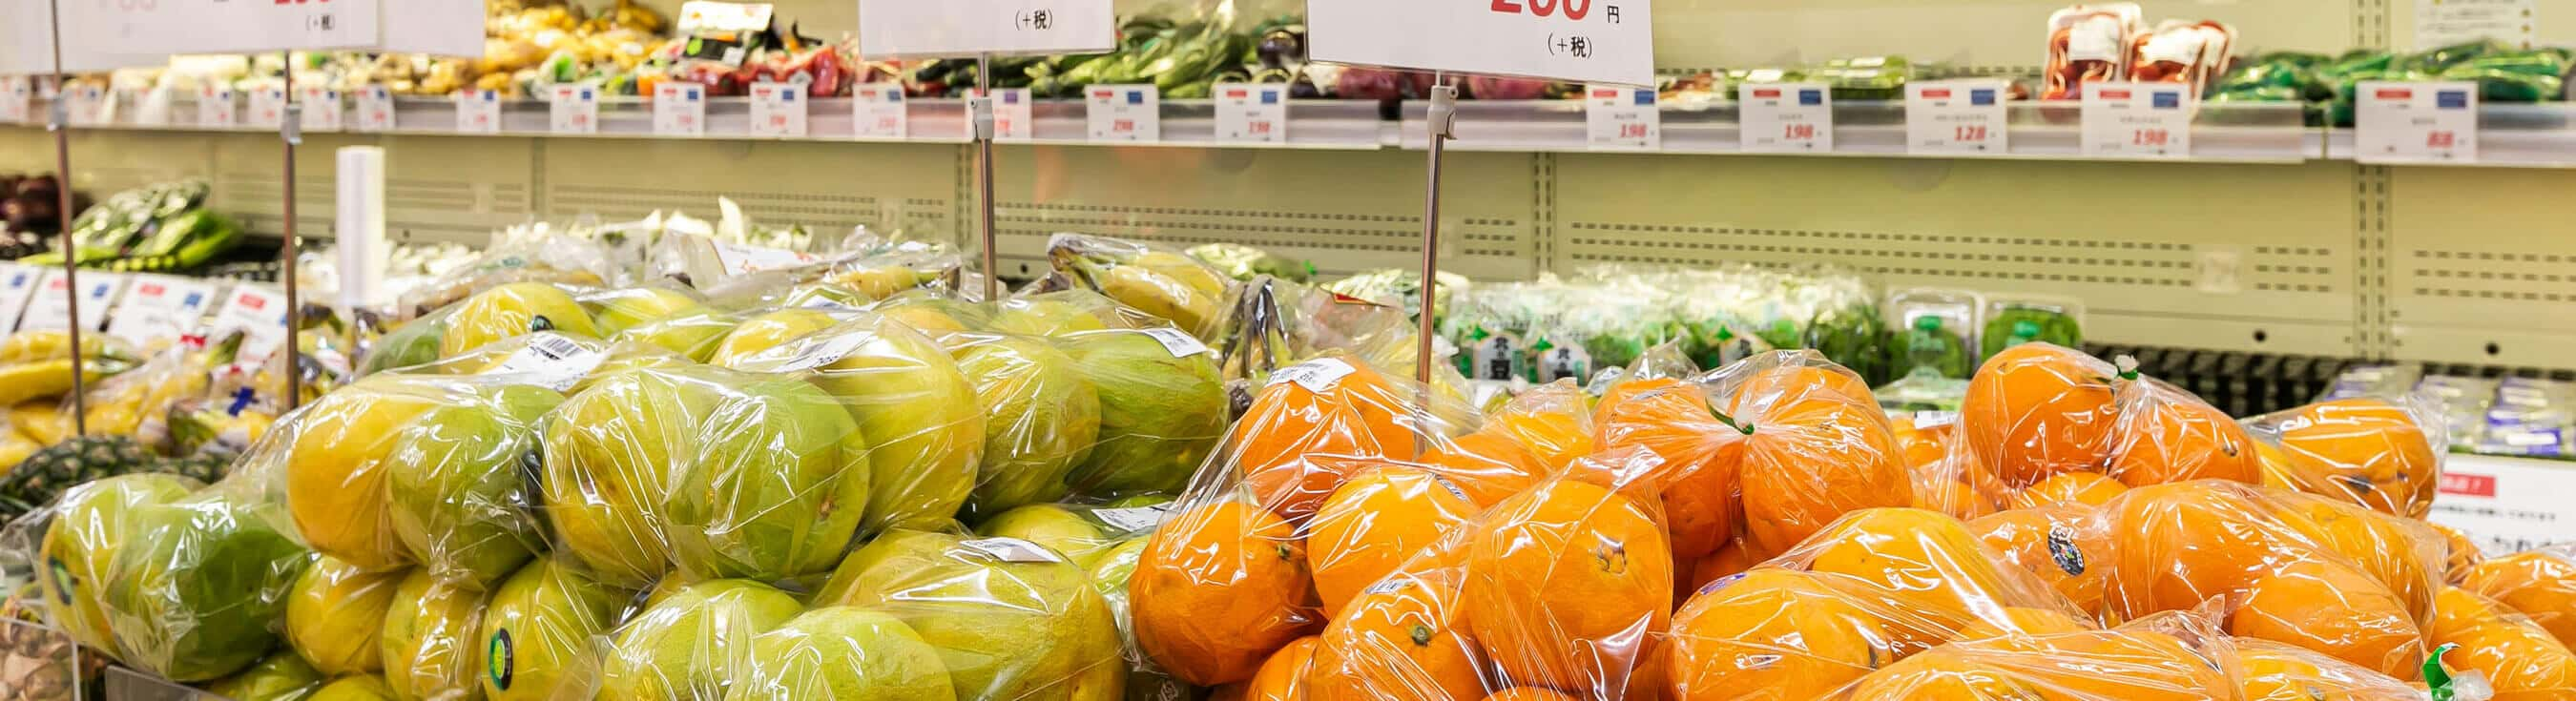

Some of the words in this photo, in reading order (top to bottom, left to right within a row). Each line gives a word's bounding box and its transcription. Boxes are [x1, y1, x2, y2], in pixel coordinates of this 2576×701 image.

[1607, 6, 1620, 24] 円
[1619, 123, 1647, 138] 198
[1784, 124, 1814, 139] 198
